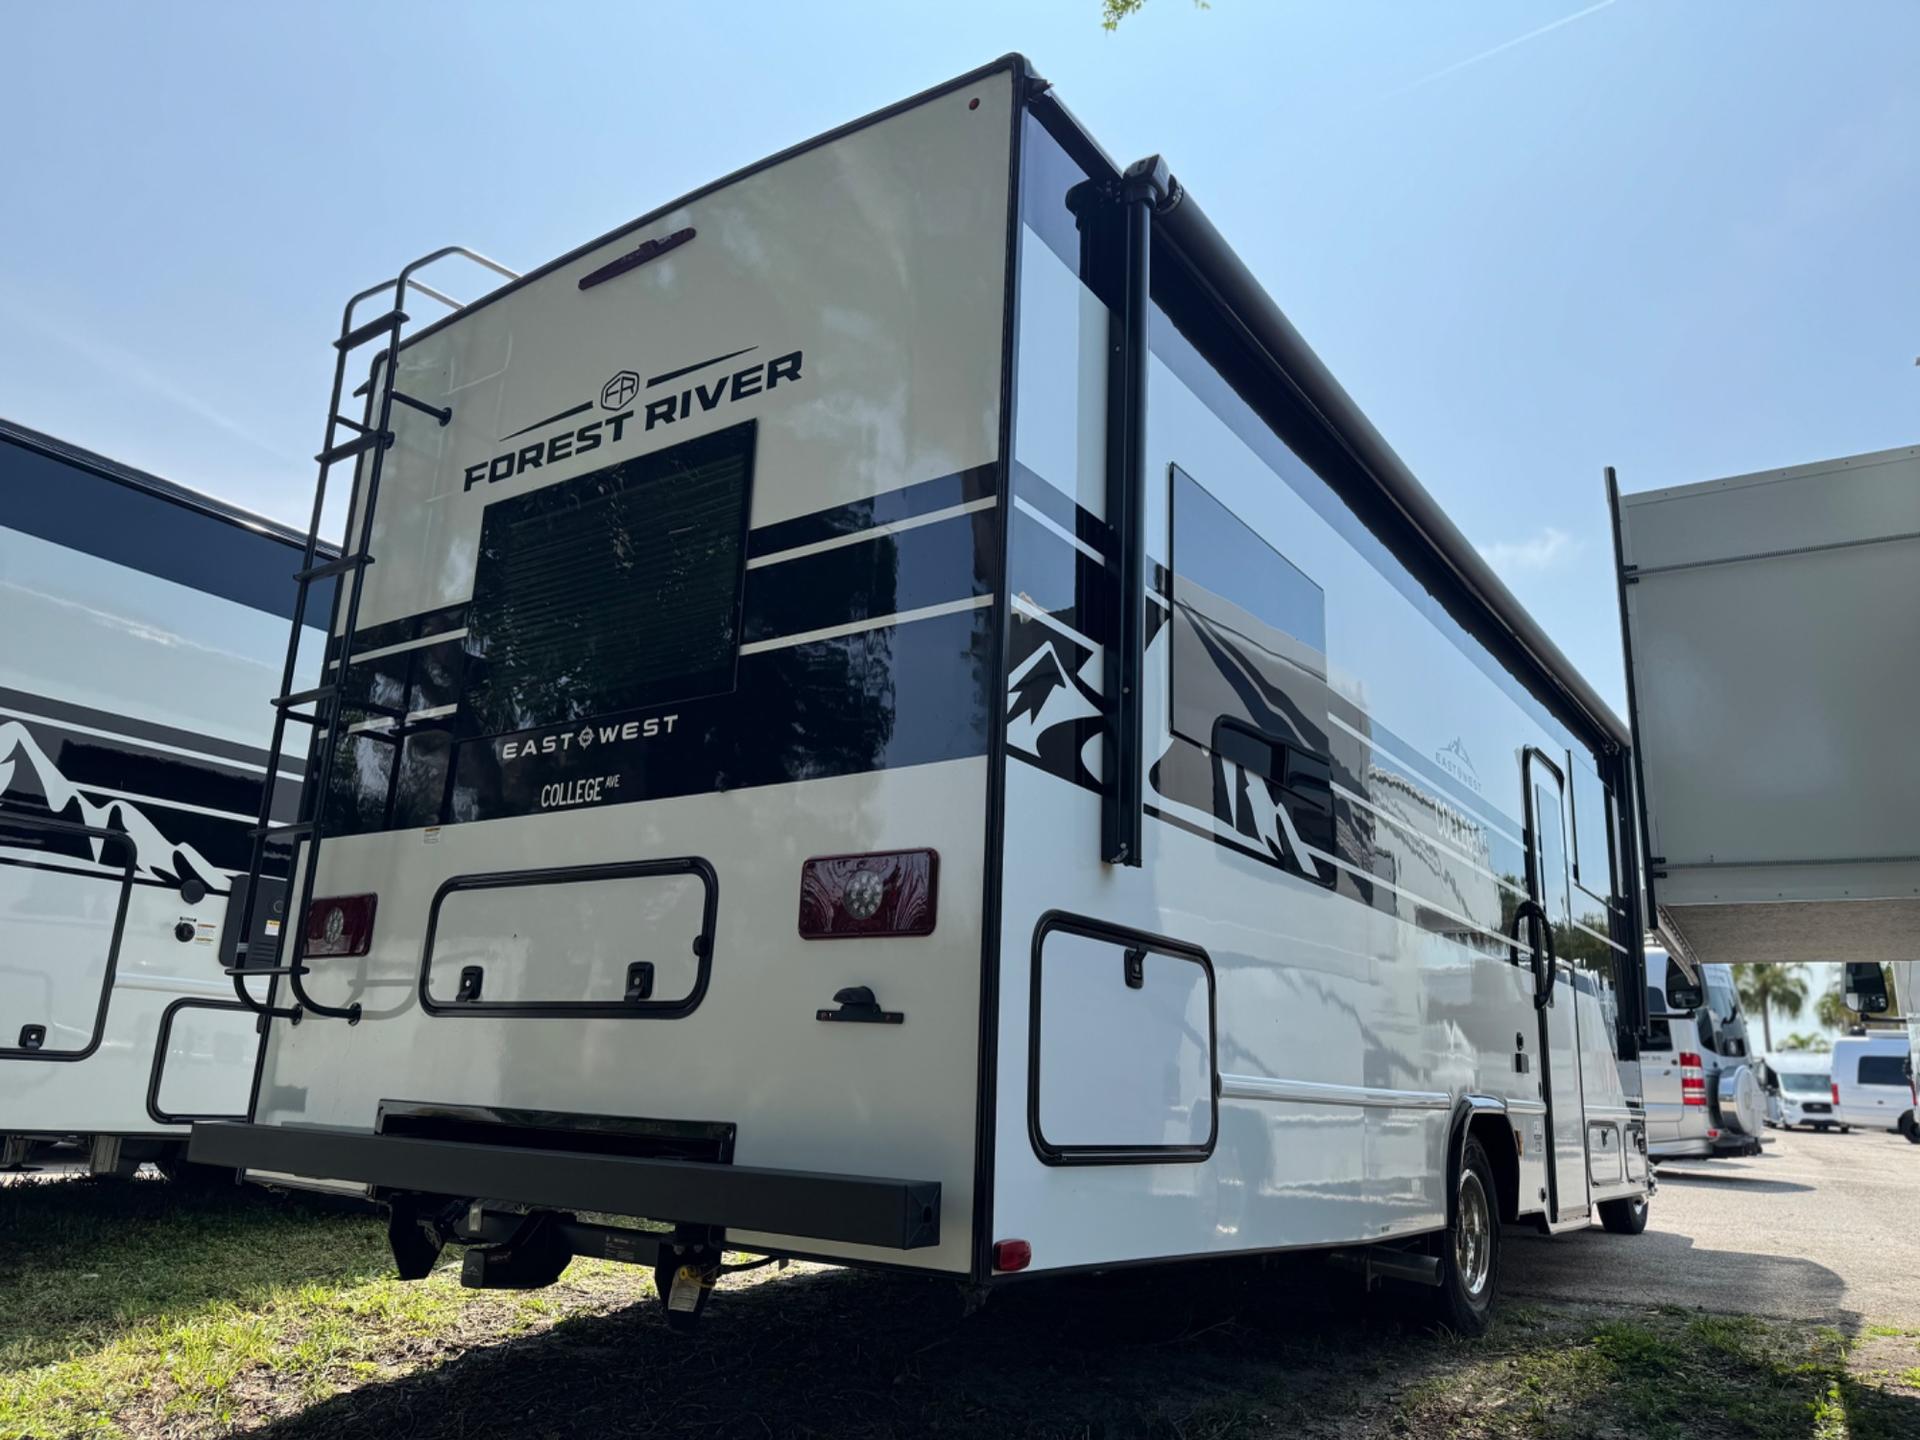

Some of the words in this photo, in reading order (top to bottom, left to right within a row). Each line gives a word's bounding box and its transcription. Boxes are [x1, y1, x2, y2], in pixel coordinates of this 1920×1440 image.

[463, 410, 634, 492] FOREST
[645, 350, 803, 431] RIVER
[502, 732, 574, 760] EAST
[599, 714, 679, 744] WEST
[541, 776, 605, 808] COLLEGE
[605, 774, 621, 789] AVE
